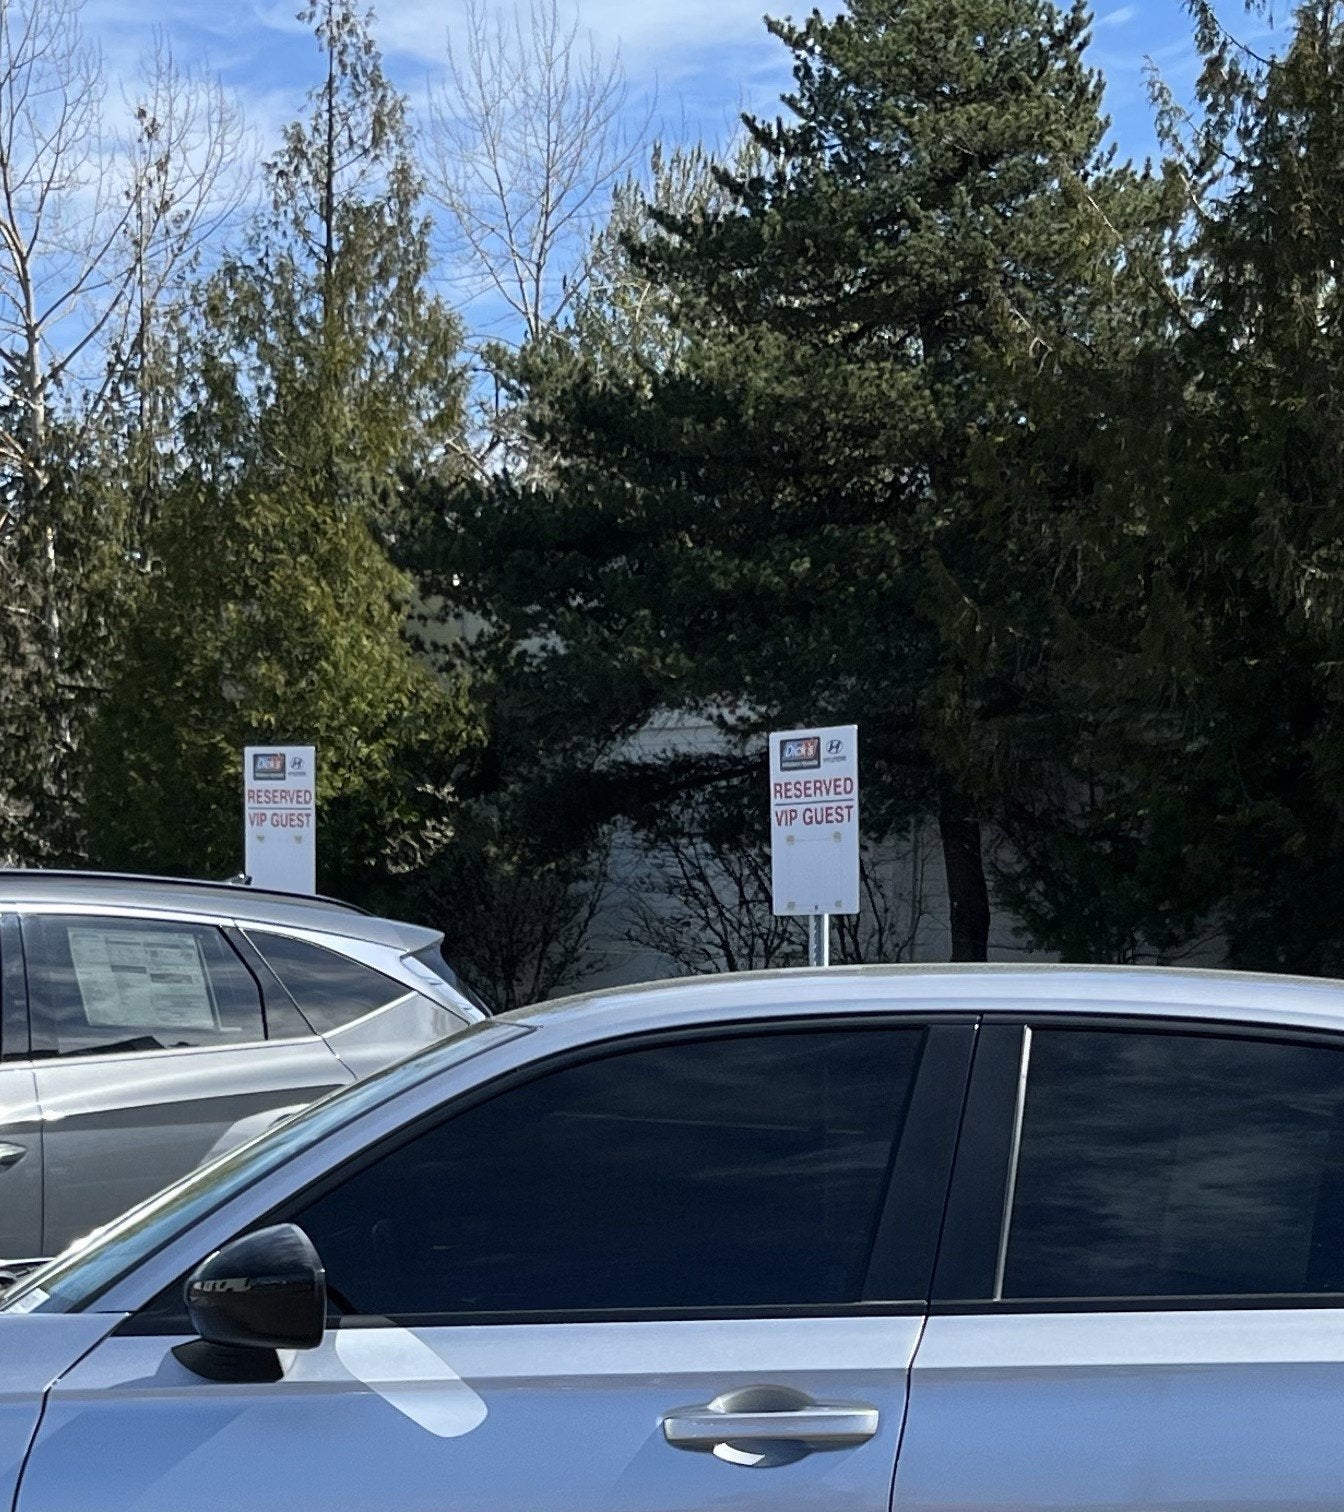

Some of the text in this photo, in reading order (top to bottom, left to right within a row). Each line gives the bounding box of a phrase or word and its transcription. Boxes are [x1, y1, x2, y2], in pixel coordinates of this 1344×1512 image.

[247, 789, 312, 804] RESERVED
[773, 777, 854, 799] RESERVED
[249, 812, 312, 828] VIP GUEST
[775, 805, 854, 826] VIP GUEST
